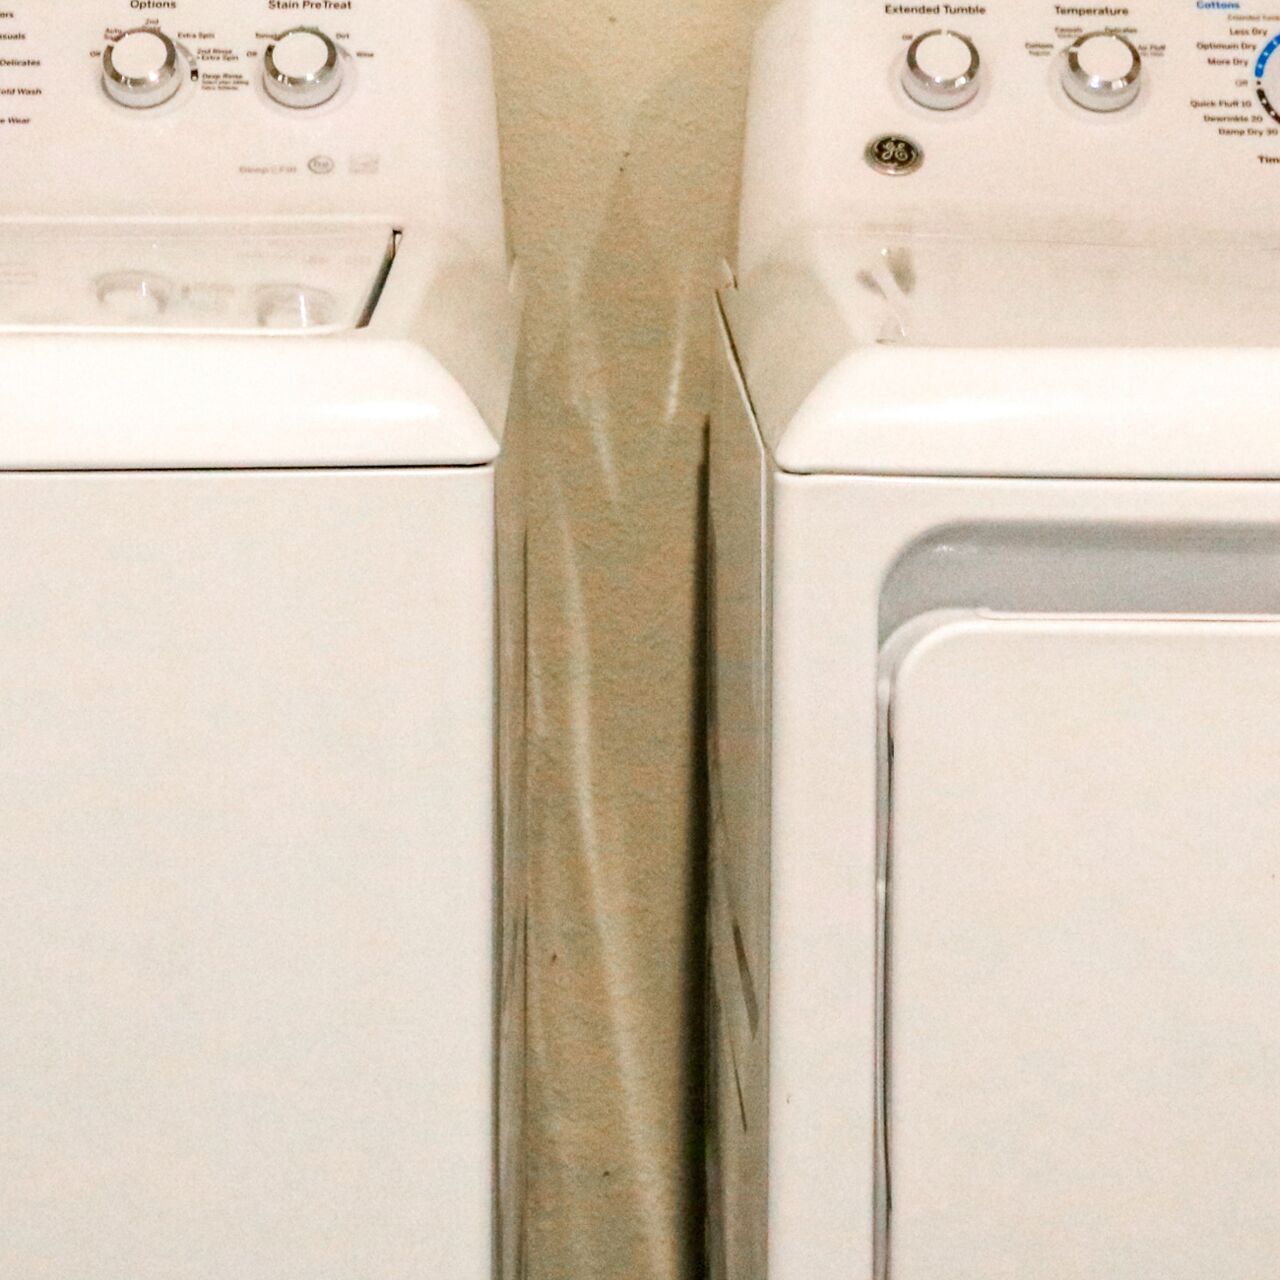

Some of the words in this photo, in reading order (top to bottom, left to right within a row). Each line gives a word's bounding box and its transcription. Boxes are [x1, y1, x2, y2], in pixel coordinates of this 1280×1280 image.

[130, 0, 177, 10] Options
[268, 0, 299, 9] Stain
[885, 4, 940, 14] Extended
[943, 4, 986, 14] Tumble
[1196, 1, 1240, 9] Cottons
[1055, 5, 1129, 16] Temperature
[1252, 28, 1268, 37] Dry
[1196, 42, 1239, 50] Optimum
[1241, 42, 1257, 50] Dry
[1233, 58, 1248, 66] Dry
[1247, 128, 1263, 136] Dry
